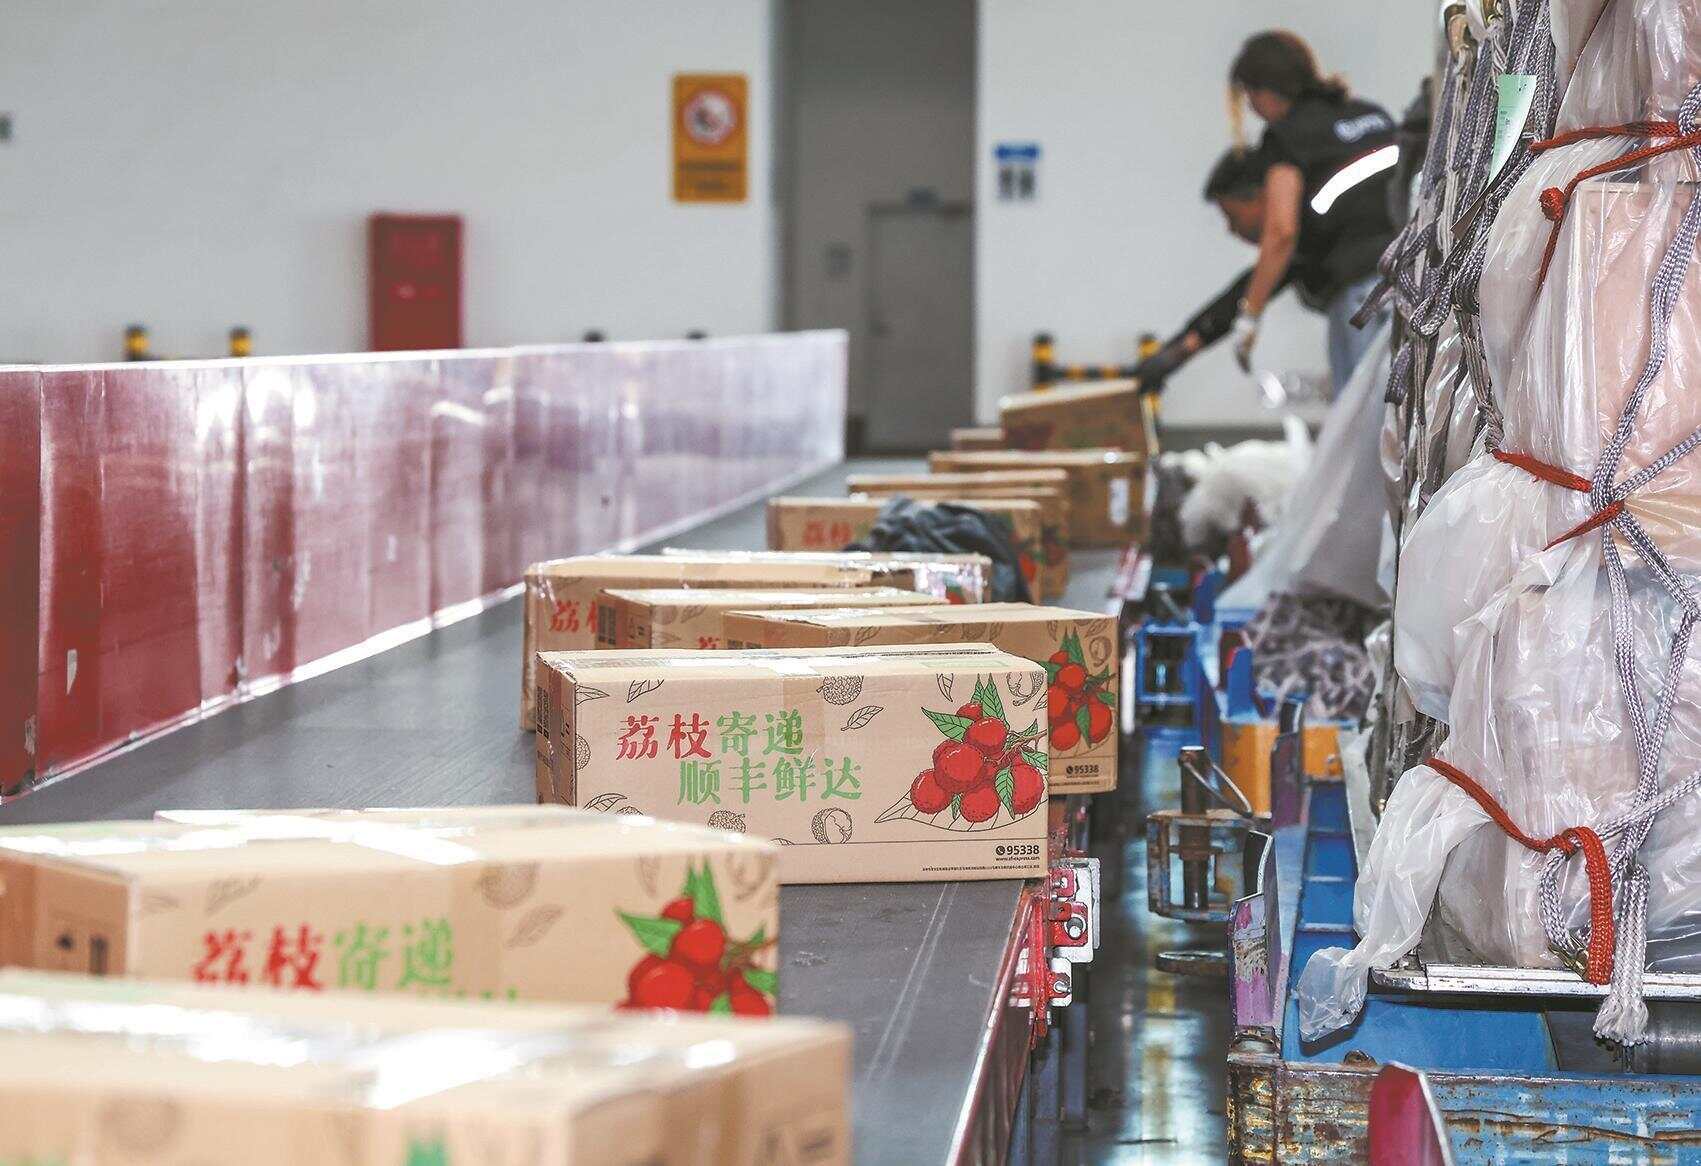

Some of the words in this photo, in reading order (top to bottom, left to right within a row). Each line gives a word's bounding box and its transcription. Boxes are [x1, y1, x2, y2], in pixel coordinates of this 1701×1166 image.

[616, 709, 804, 760] 荔枝寄递
[677, 757, 862, 805] 顺丰鲜达
[1074, 764, 1099, 774] 95338
[1006, 845, 1040, 855] 95338
